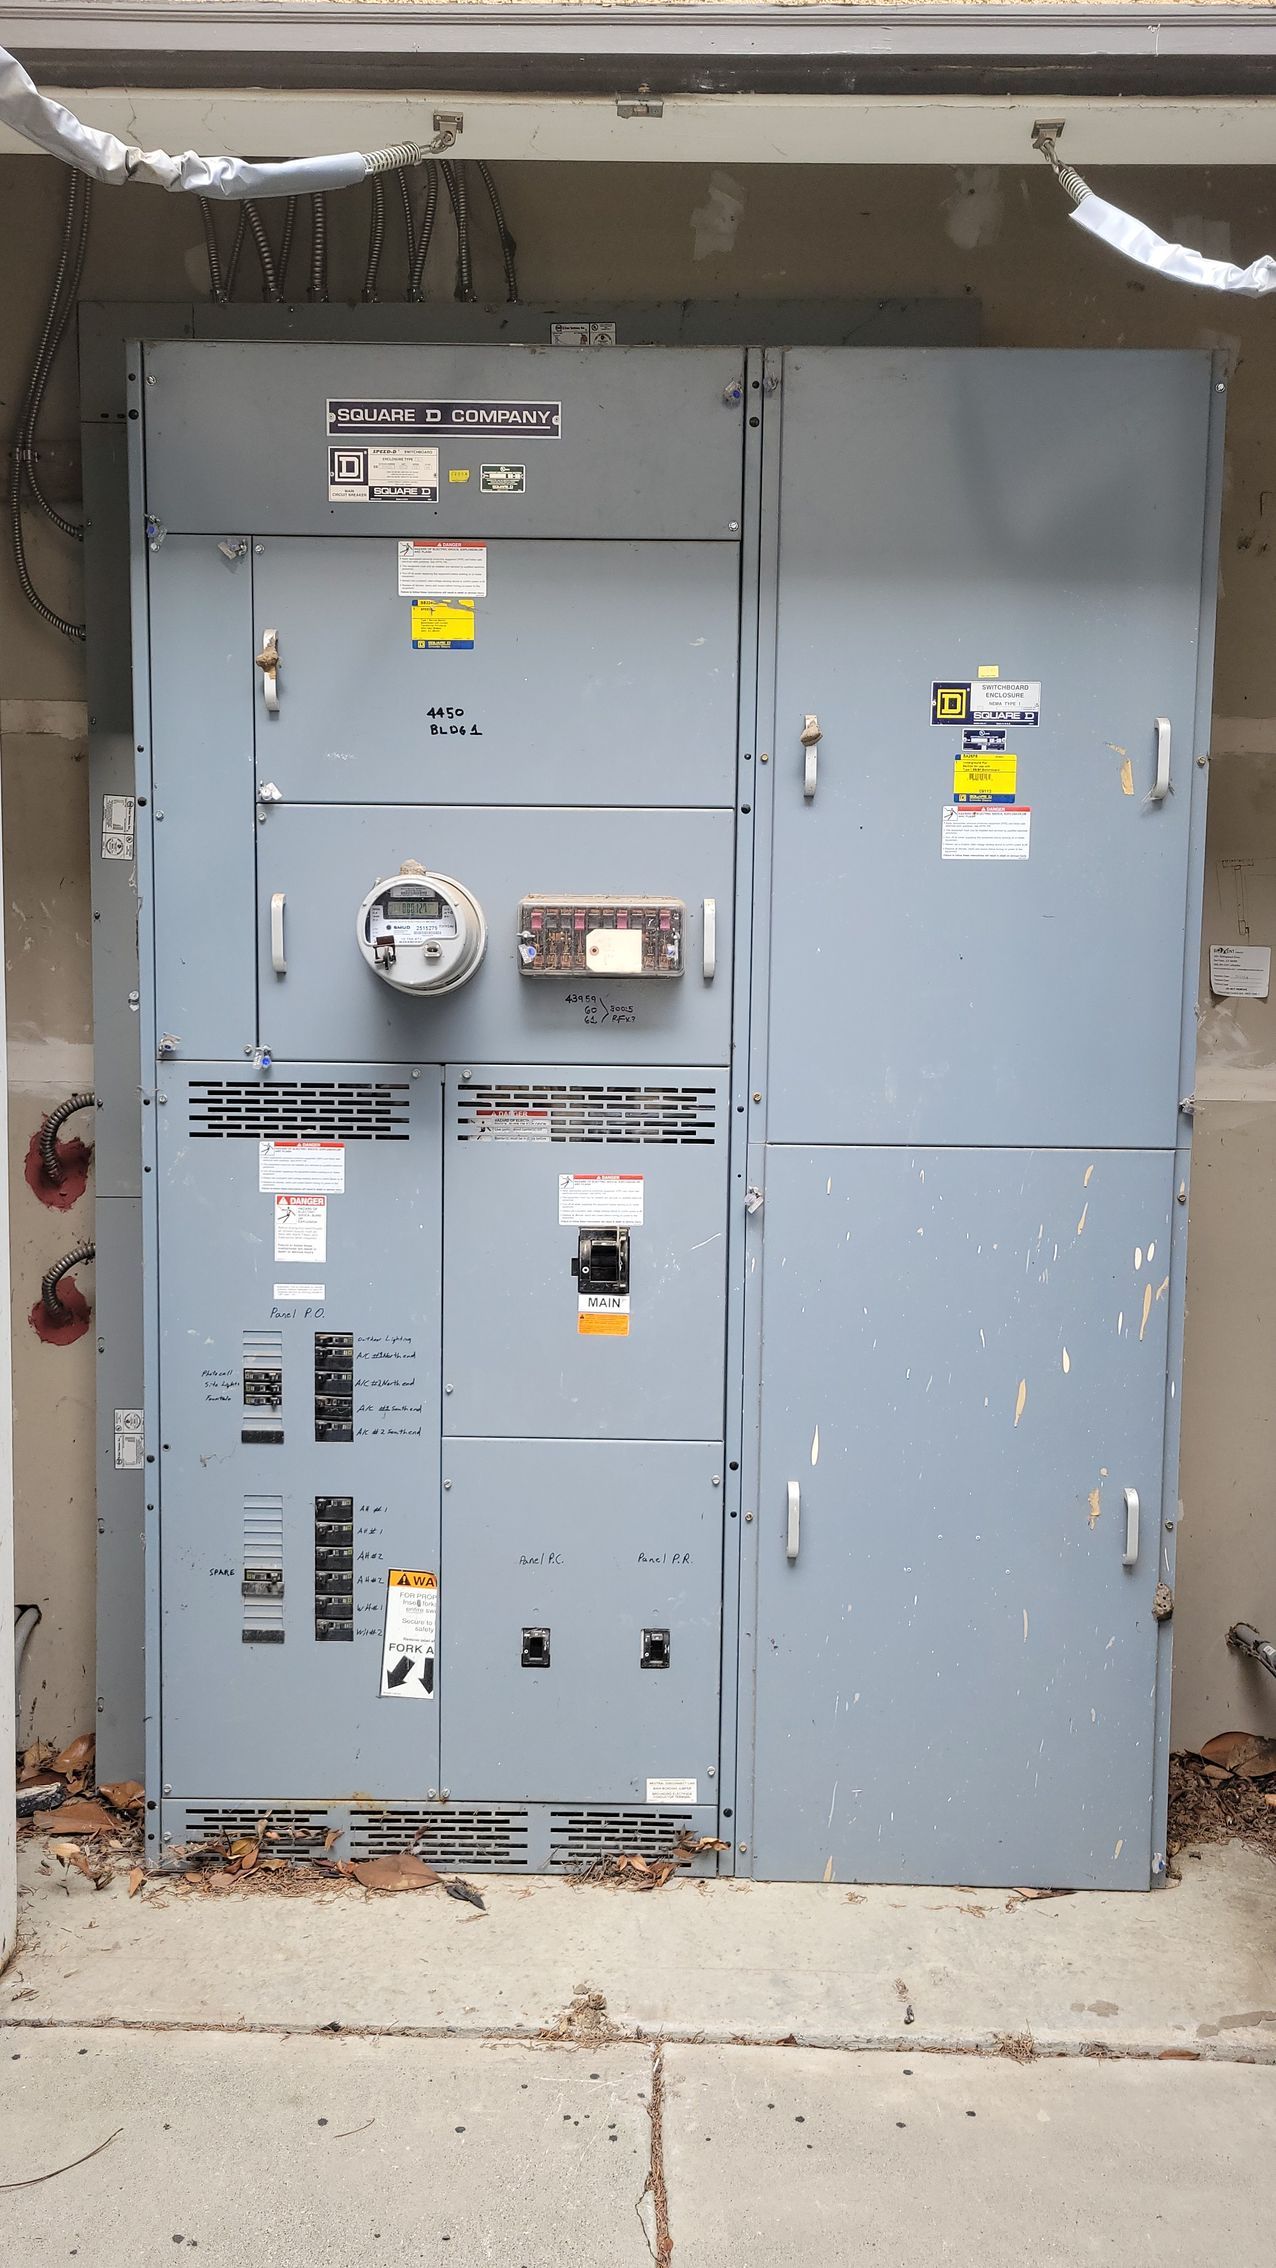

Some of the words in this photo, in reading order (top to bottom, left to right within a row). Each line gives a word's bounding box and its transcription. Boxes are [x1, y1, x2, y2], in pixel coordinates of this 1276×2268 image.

[338, 409, 416, 422] SQUARE
[425, 409, 442, 422] D
[451, 409, 551, 424] COMPANY
[339, 456, 359, 477] D
[373, 487, 418, 495] SQUARE
[941, 693, 962, 714] D
[426, 706, 464, 719] 4450
[973, 711, 1021, 720] SQUARE
[1024, 712, 1035, 720] D
[430, 723, 466, 735] BLDG
[469, 724, 483, 735] 1
[565, 994, 597, 1003] 43959
[584, 1005, 598, 1014] 60
[584, 1015, 598, 1024] 61
[289, 1196, 324, 1205] DANGER
[588, 1297, 621, 1308] MAIN
[270, 1307, 296, 1319] Panel
[519, 1553, 545, 1565] Panel
[637, 1552, 667, 1564] Panel
[209, 1568, 236, 1577] SPARE
[413, 1575, 438, 1587] WA
[399, 1591, 415, 1599] FOR
[401, 1617, 425, 1625] Secure
[388, 1643, 423, 1654] FORK
